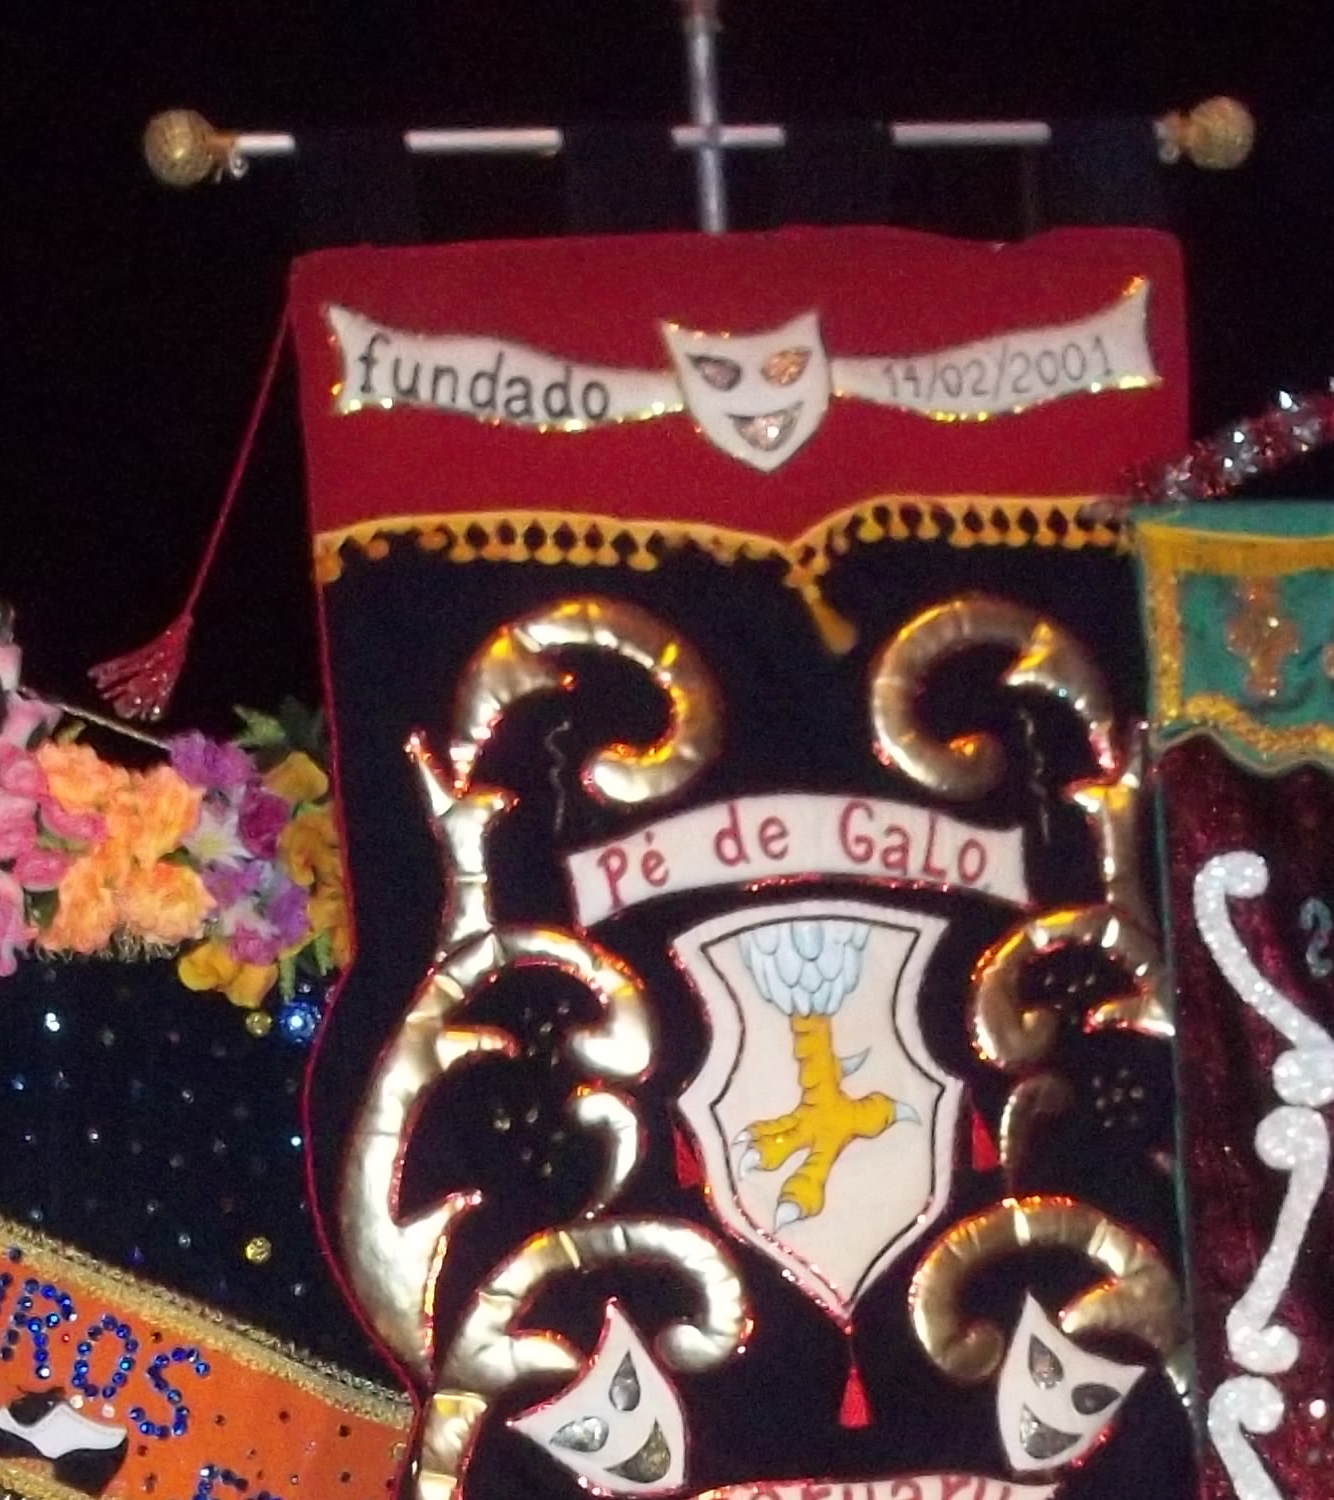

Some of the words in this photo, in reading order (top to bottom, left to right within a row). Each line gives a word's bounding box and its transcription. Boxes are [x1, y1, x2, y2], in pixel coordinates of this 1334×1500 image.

[357, 330, 611, 421] fundado
[882, 335, 1113, 400] 14/02/2001
[597, 830, 668, 909] Pé
[713, 800, 791, 868] de
